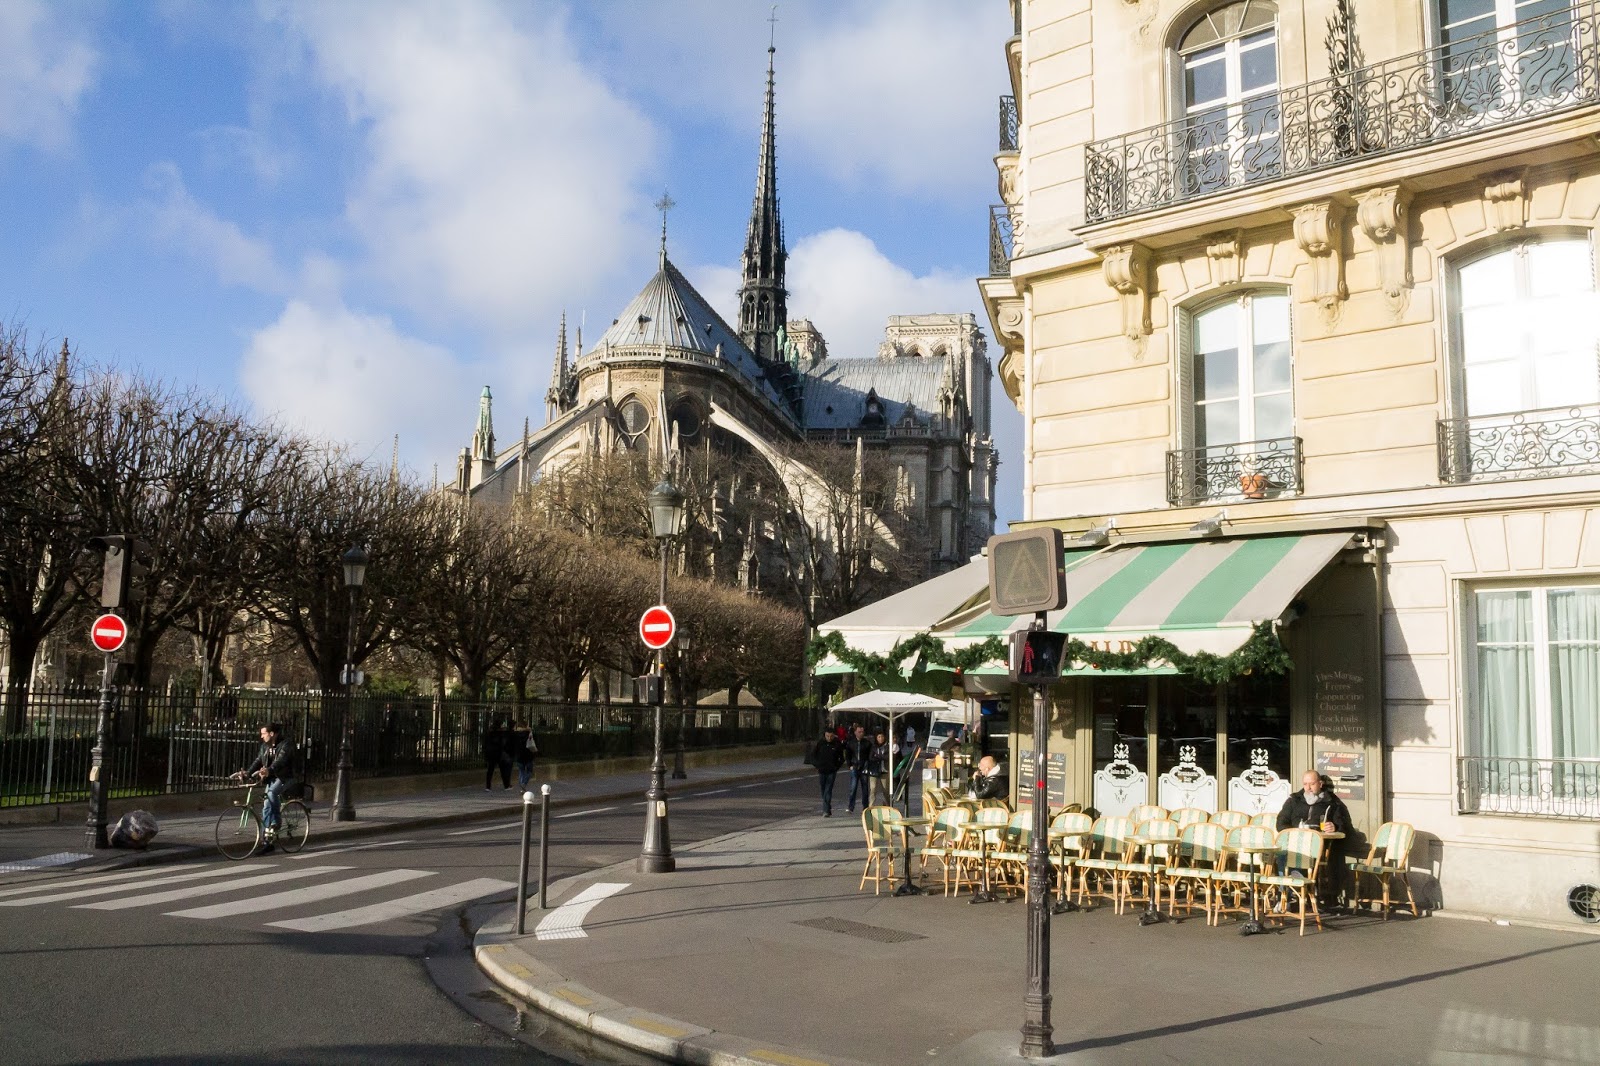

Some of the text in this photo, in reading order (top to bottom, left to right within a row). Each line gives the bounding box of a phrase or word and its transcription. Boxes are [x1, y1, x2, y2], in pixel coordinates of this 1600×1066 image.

[1315, 693, 1363, 701] Cappuccino
[1319, 702, 1355, 711] Chocolat
[1317, 714, 1358, 722] Cocktails
